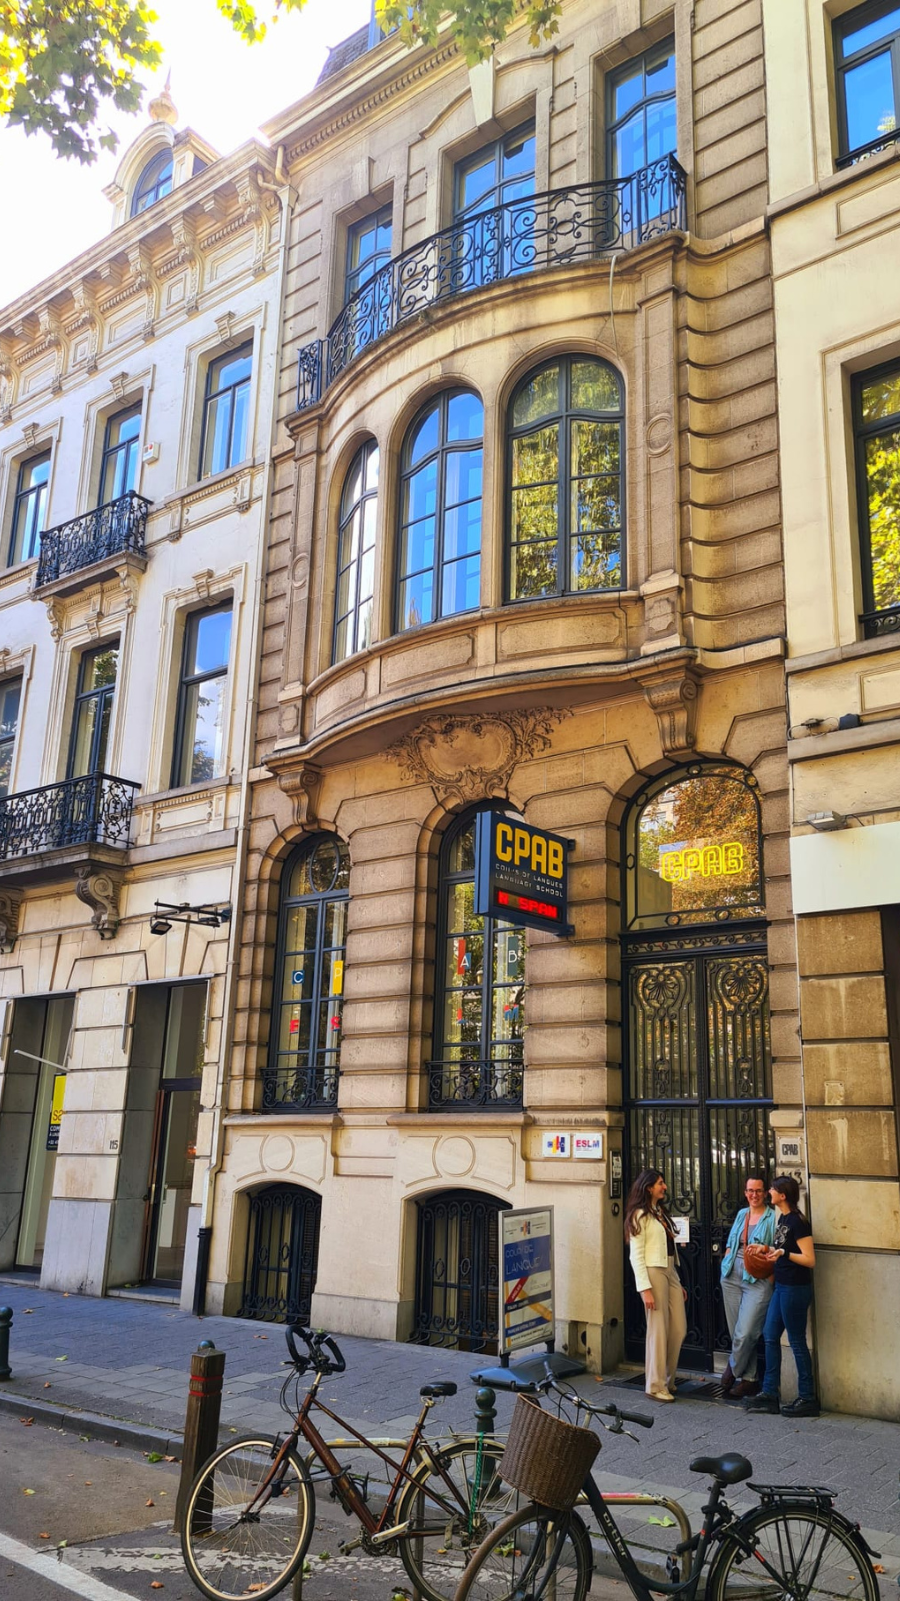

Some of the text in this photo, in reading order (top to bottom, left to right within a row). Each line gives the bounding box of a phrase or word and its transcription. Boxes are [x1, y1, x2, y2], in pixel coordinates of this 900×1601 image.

[496, 822, 564, 879] CPAB
[662, 842, 743, 882] CPAB
[496, 872, 563, 898] LANGUAGE SCHOOL
[534, 875, 563, 888] LANGUES
[460, 950, 518, 968] A B
[294, 968, 342, 983] C P
[504, 1004, 519, 1021] M
[110, 1140, 118, 1150] 115
[576, 1140, 600, 1148] ESLM
[782, 1144, 798, 1156] CPAB
